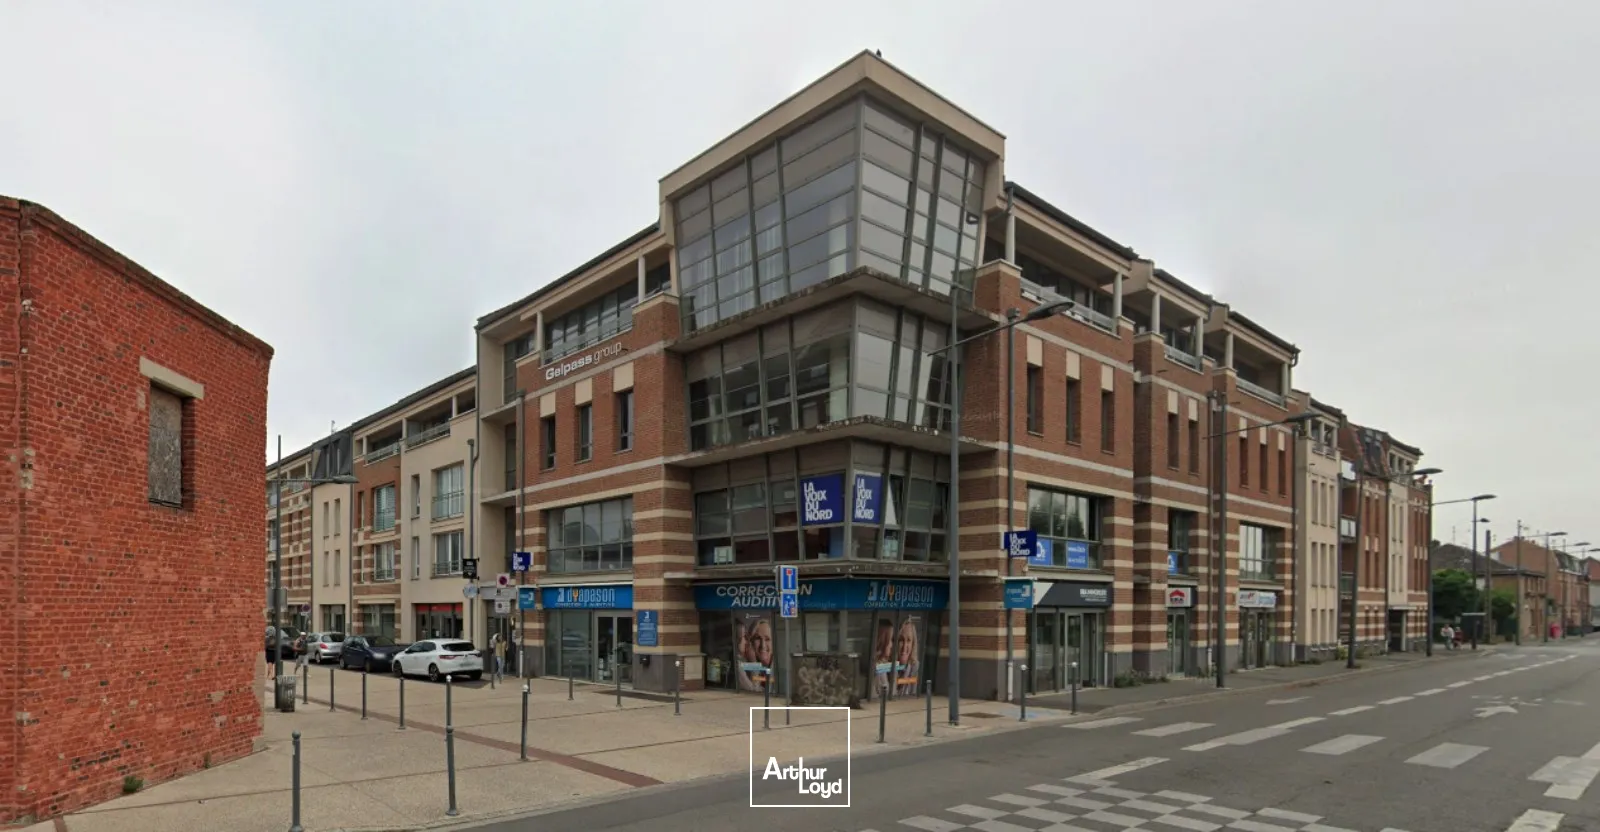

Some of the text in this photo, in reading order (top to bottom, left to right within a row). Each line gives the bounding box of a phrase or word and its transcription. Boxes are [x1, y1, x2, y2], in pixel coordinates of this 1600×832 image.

[545, 341, 622, 381] Gelpass group
[803, 482, 814, 493] LA
[857, 478, 865, 488] LA
[804, 490, 827, 501] VOIX
[857, 488, 872, 500] VOIX
[805, 500, 819, 511] DU
[856, 498, 867, 508] DU
[805, 509, 833, 521] NORD
[855, 508, 874, 520] NORD
[716, 583, 813, 597] CORRECN
